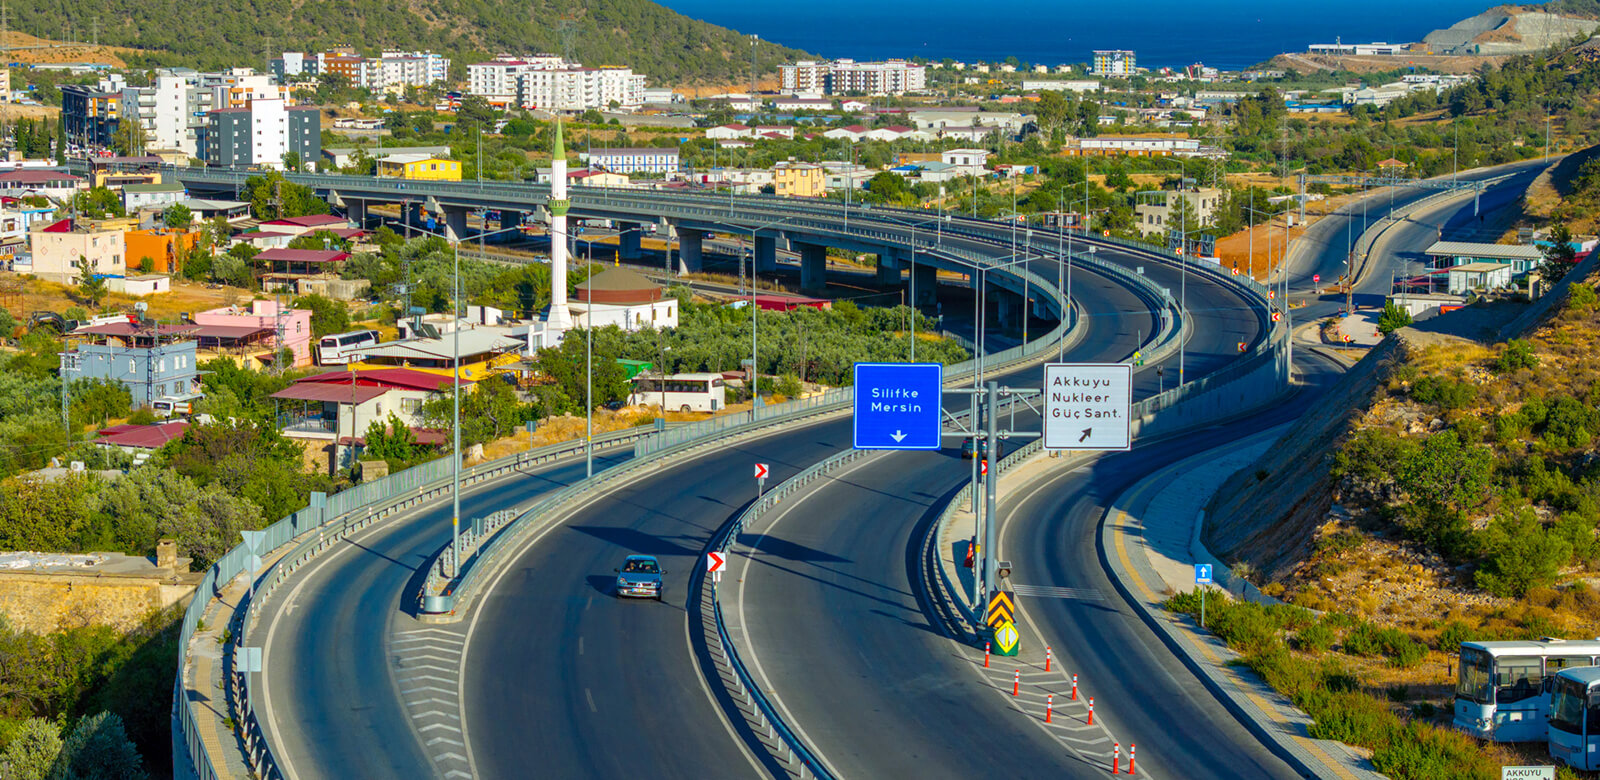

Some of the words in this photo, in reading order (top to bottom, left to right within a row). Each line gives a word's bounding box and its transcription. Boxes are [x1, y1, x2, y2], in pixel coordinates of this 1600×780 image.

[1053, 376, 1110, 389] Akkuyu
[871, 387, 919, 399] Silifke
[1052, 392, 1110, 403] Nukleer
[871, 402, 921, 412] Mersin
[1052, 407, 1080, 419] Güç
[1084, 407, 1121, 418] Sant.
[1506, 769, 1542, 777] AKKUYU
